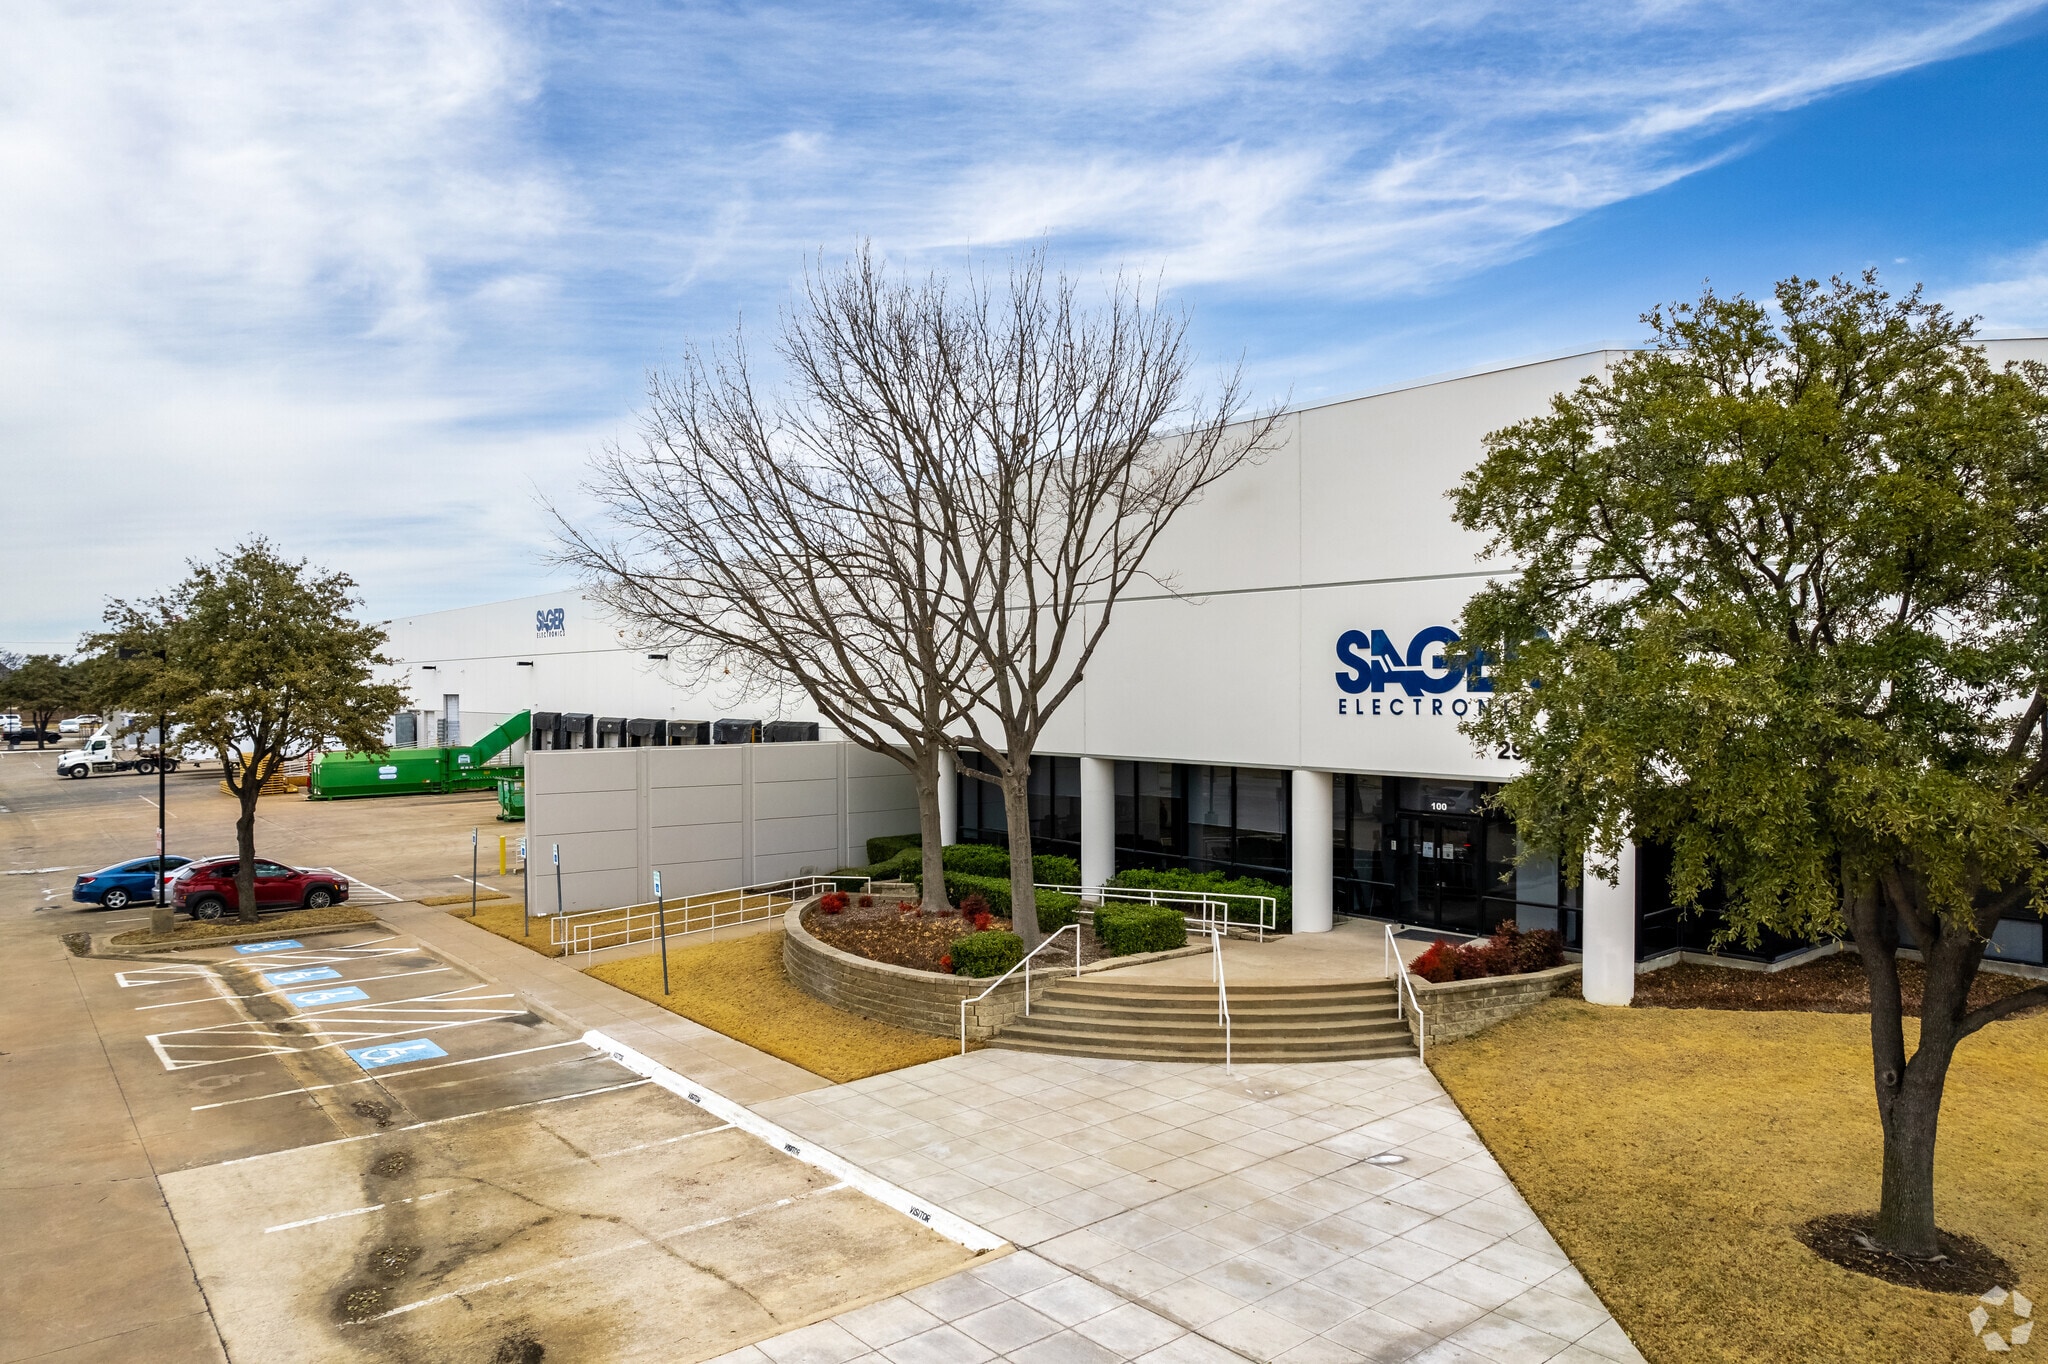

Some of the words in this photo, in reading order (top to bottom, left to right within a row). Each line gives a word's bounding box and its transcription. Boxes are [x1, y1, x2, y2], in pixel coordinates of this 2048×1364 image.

[536, 608, 565, 633] SAGER
[1335, 625, 1550, 697] SAGE
[1430, 802, 1448, 811] 100
[784, 1142, 801, 1157] VISITOR
[909, 1205, 932, 1223] VISITOR
